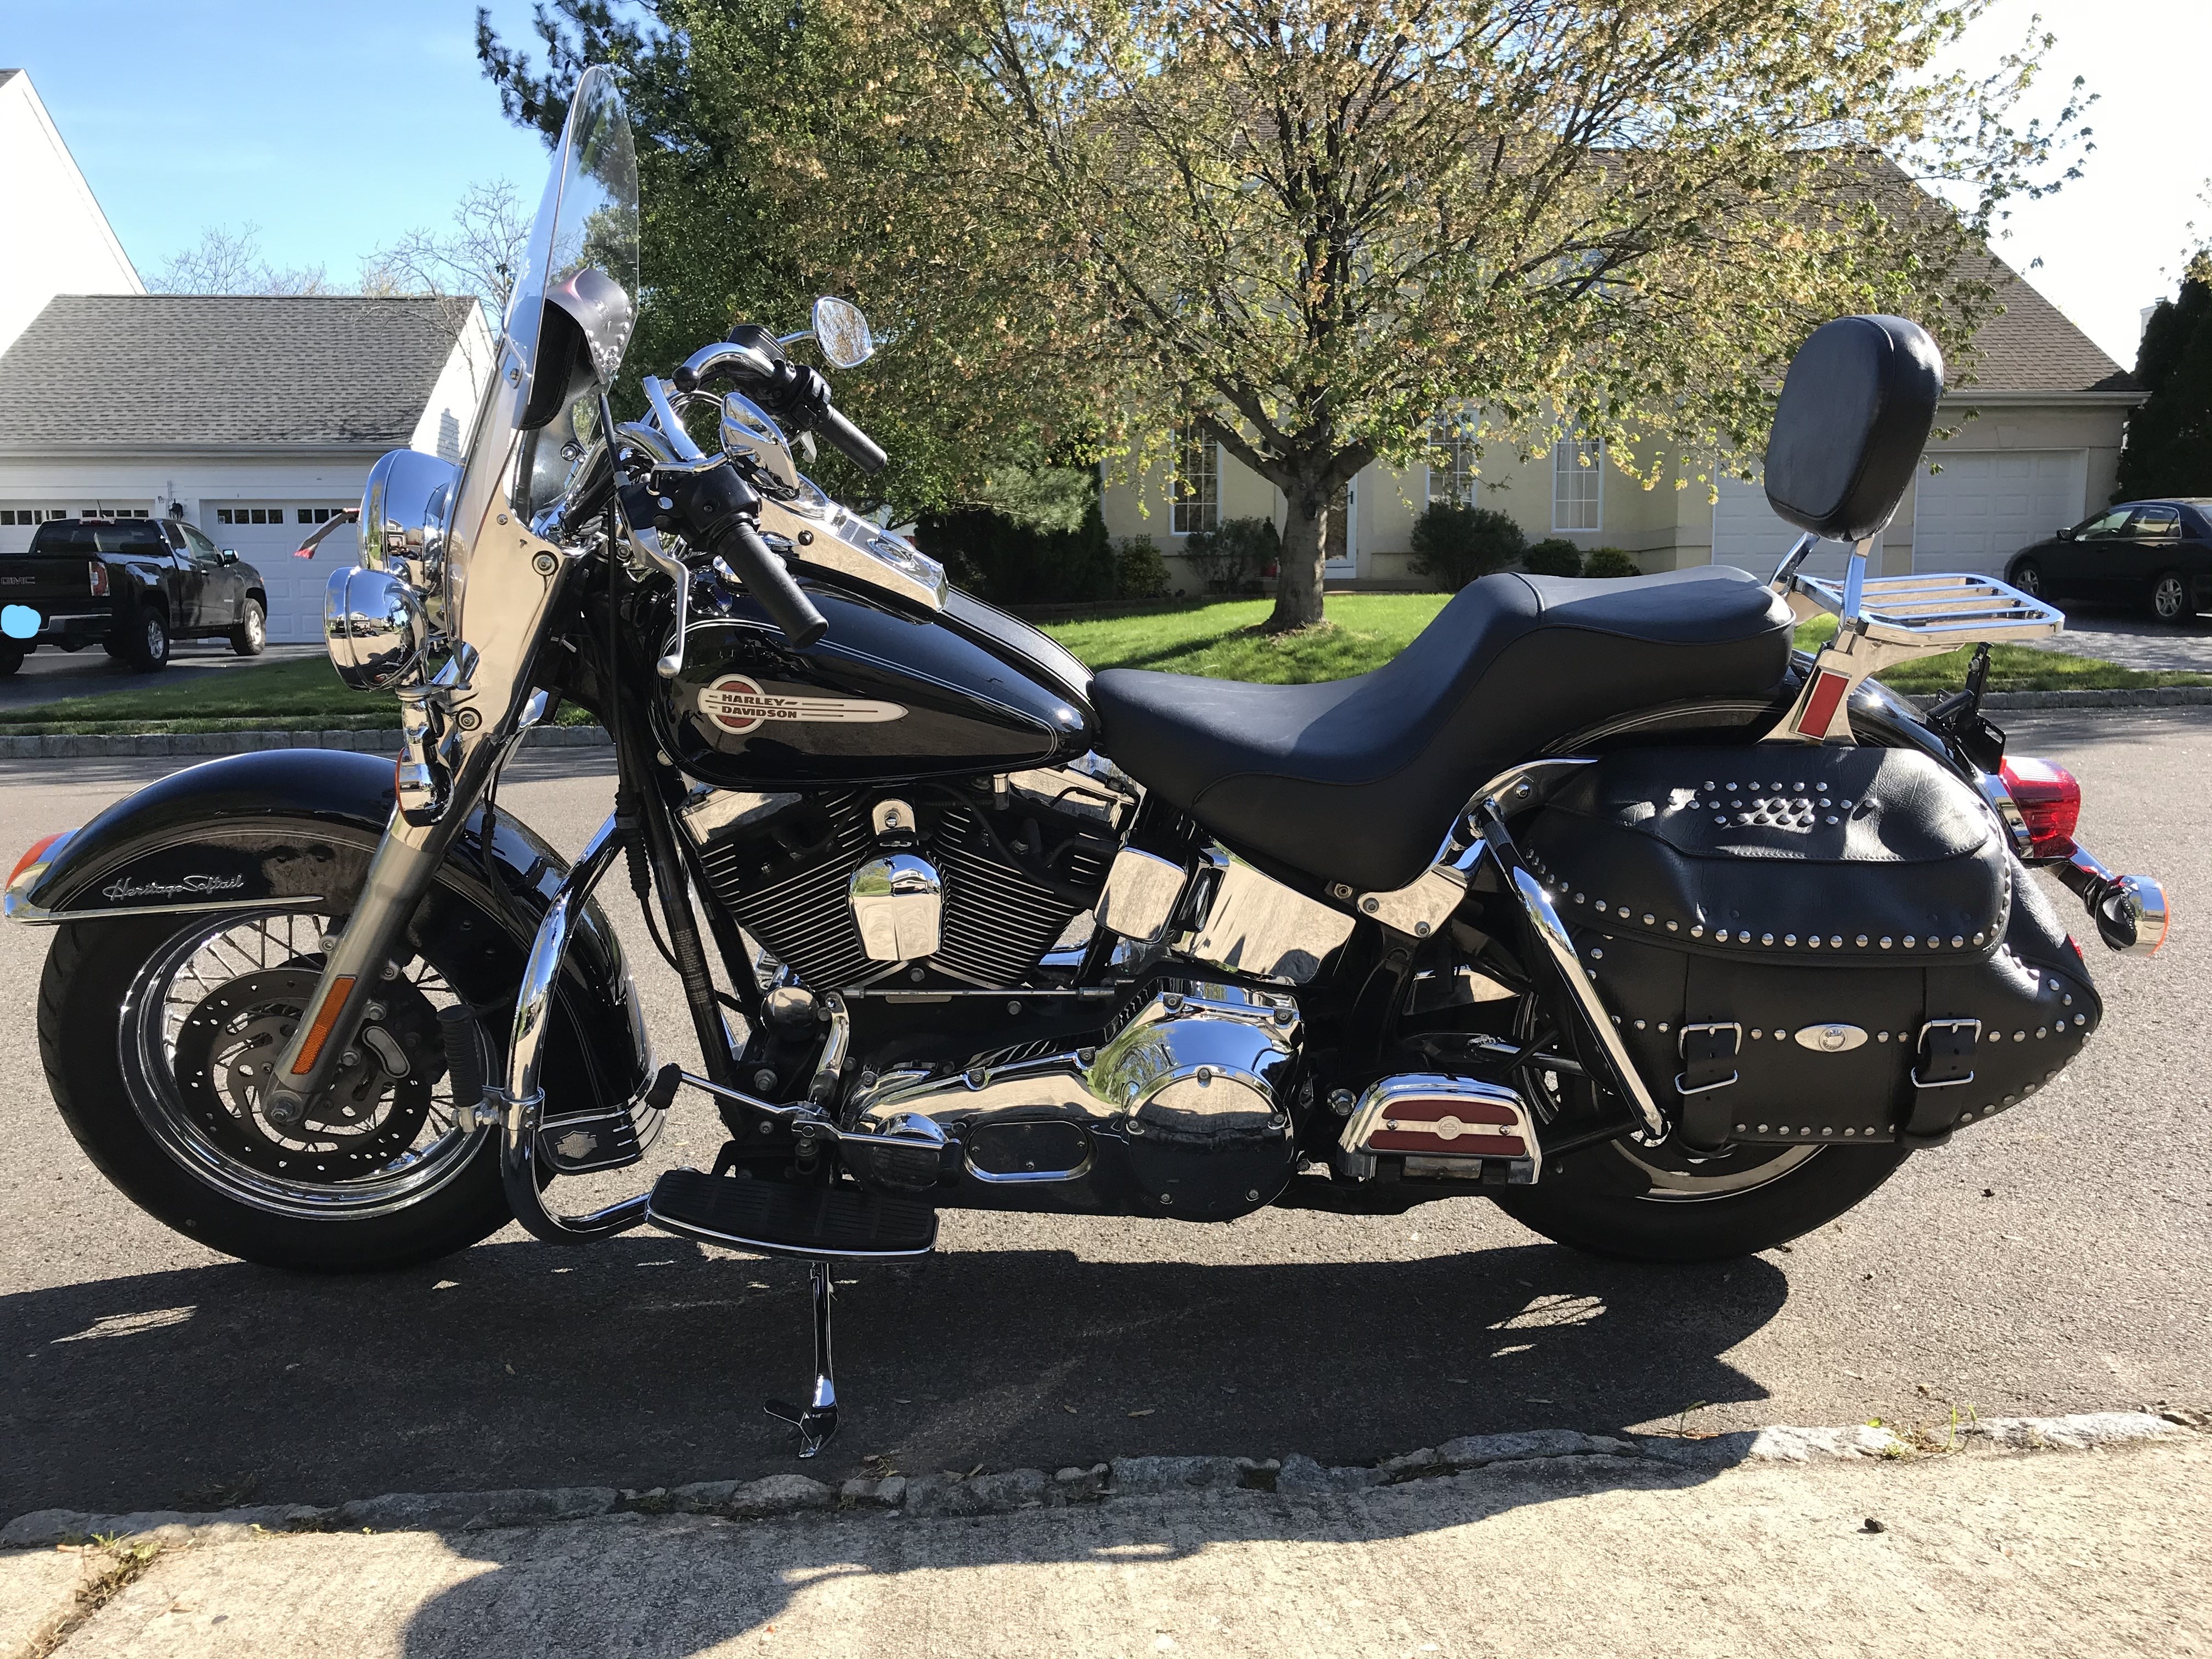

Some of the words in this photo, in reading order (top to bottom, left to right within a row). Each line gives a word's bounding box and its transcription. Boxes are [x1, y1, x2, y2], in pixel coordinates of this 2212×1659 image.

[721, 706, 798, 719] DAVIDSON
[102, 877, 184, 902] Heritage
[183, 874, 245, 896] Softail
